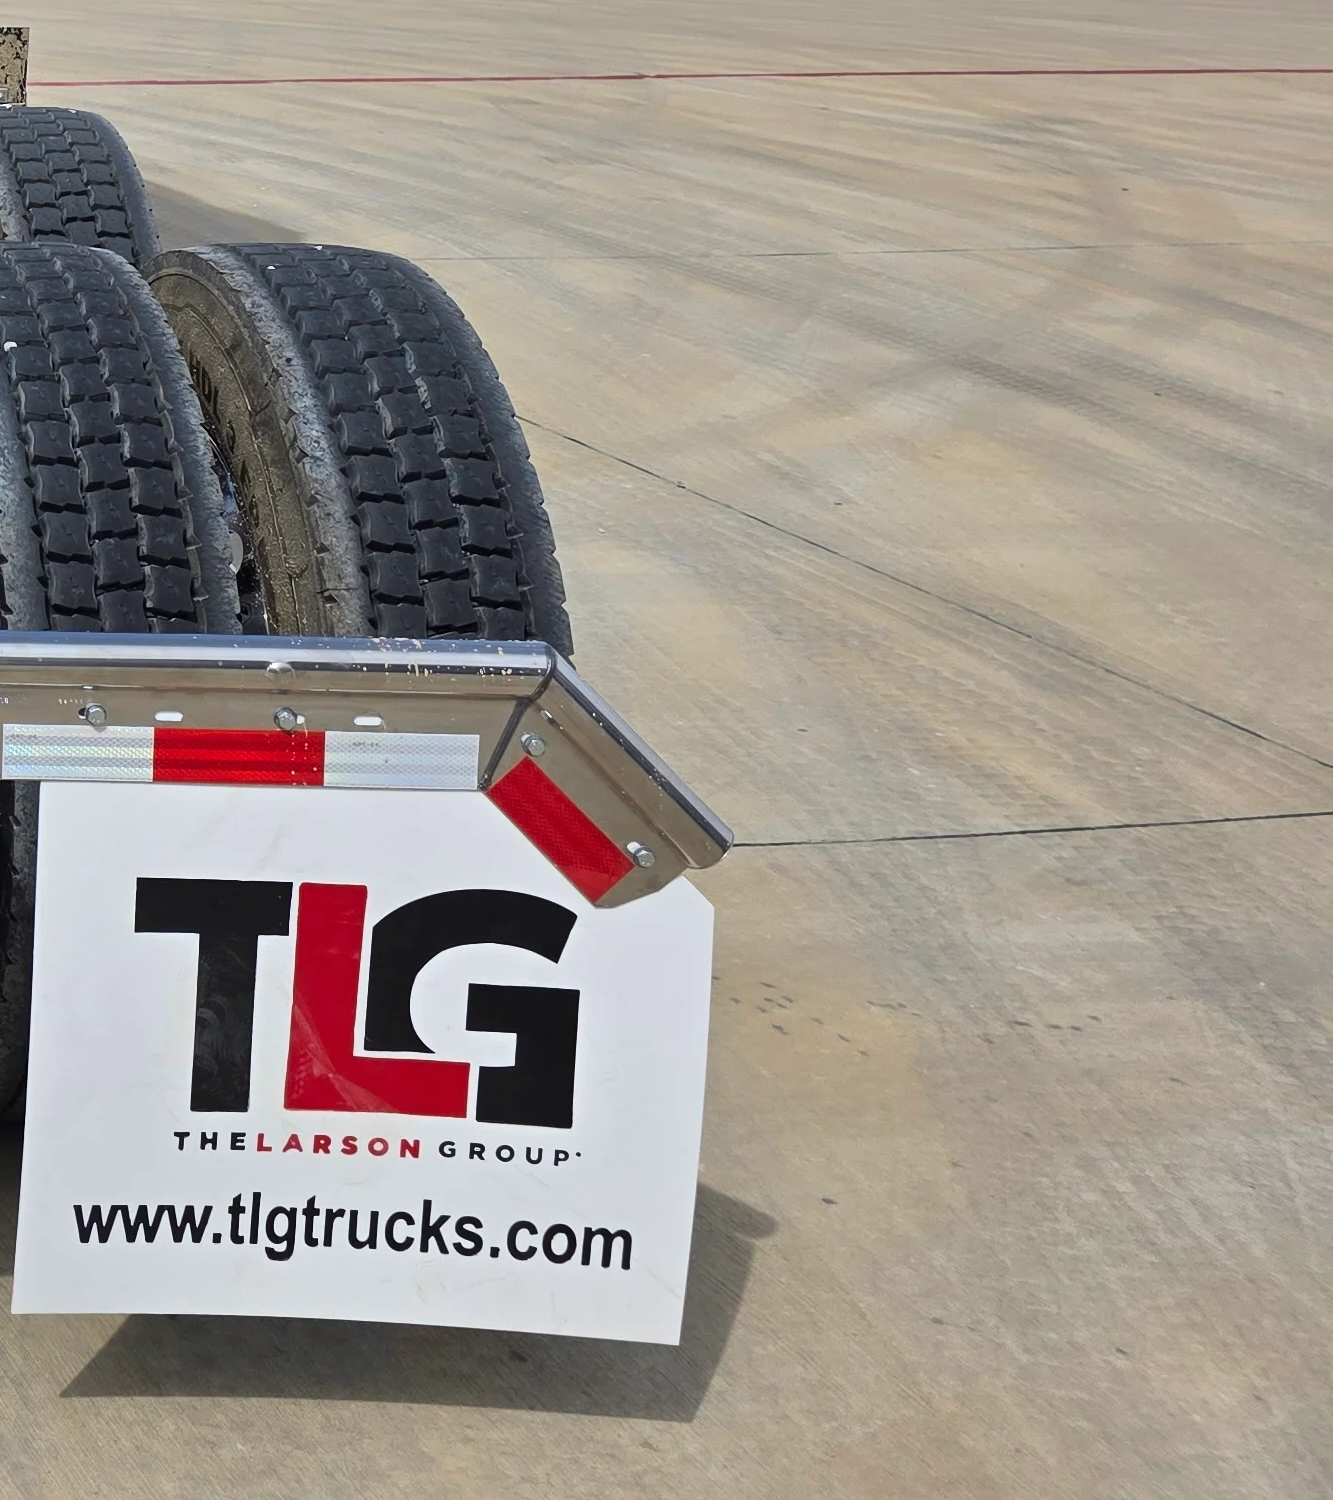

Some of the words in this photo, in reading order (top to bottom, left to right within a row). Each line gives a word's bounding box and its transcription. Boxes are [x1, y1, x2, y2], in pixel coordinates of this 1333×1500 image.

[134, 877, 581, 1129] TLG
[438, 1138, 572, 1168] GROUP
[72, 1190, 633, 1271] www.tlgtrucks.com
